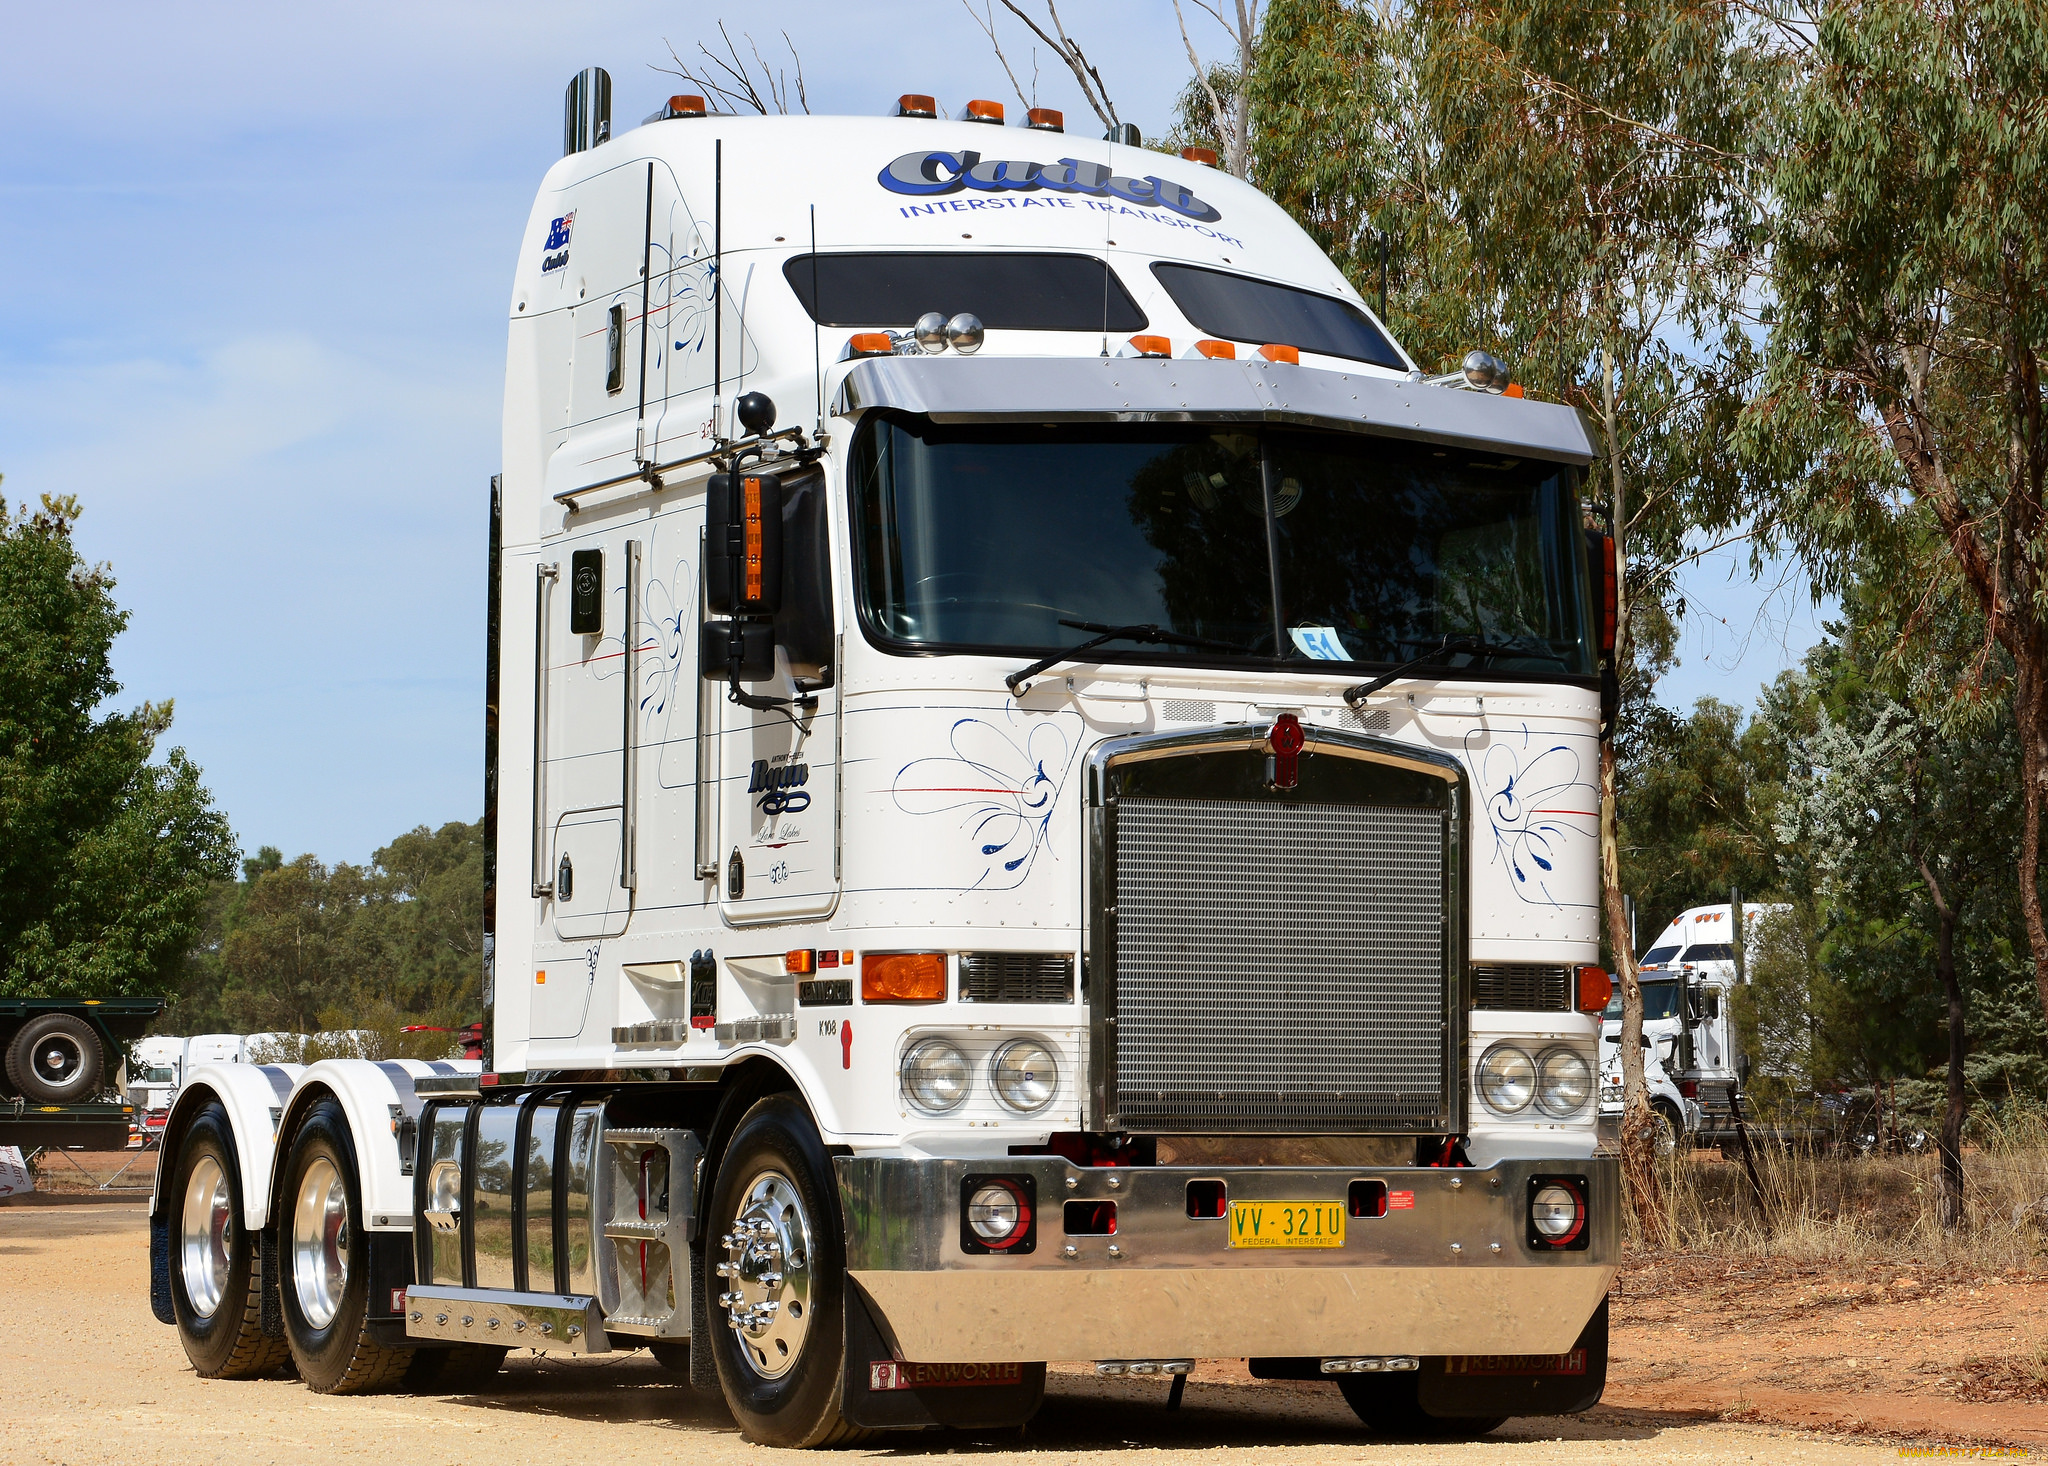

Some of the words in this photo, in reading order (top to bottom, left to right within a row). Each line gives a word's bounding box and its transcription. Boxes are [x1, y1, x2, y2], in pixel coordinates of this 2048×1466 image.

[878, 150, 1222, 223] Cadeb
[899, 197, 1076, 219] INTERSTATE
[1081, 200, 1245, 249] TRANSPORT
[1302, 633, 1341, 660] 51
[748, 759, 811, 815] Ryan
[818, 1020, 837, 1036] K108
[1242, 1238, 1281, 1246] FEDERAL
[1285, 1237, 1333, 1246] INTERSTATE
[1472, 1351, 1583, 1371] KENWORTH
[901, 1363, 1018, 1384] KENWORTH
